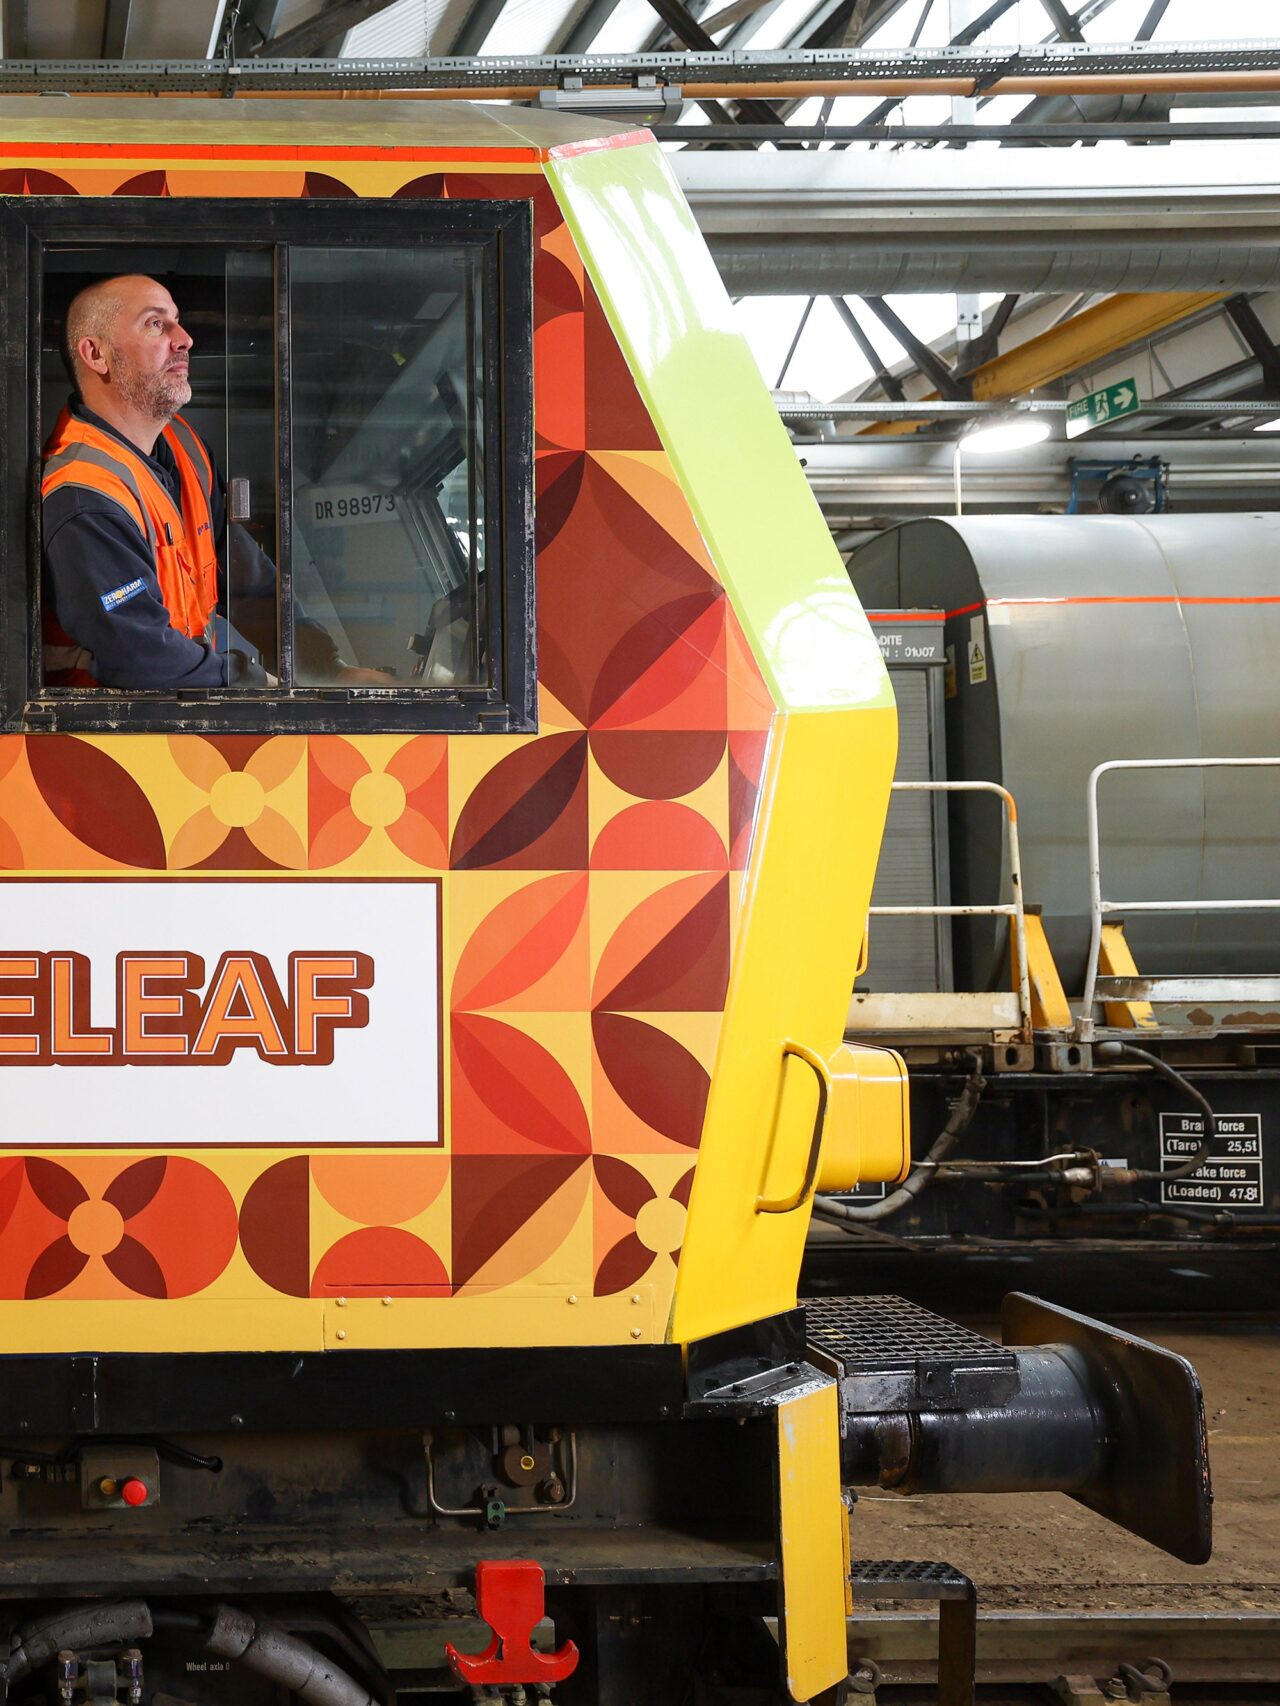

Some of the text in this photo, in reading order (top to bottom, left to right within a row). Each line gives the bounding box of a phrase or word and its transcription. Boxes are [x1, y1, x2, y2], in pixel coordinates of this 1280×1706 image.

[1069, 399, 1089, 419] FIRE
[315, 494, 396, 520] DR 98973
[1218, 1120, 1246, 1132] force
[1227, 1140, 1257, 1153] 25,5t
[1219, 1166, 1247, 1178] force
[1167, 1185, 1222, 1200] (Loaded)
[186, 1661, 207, 1671] Wheel
